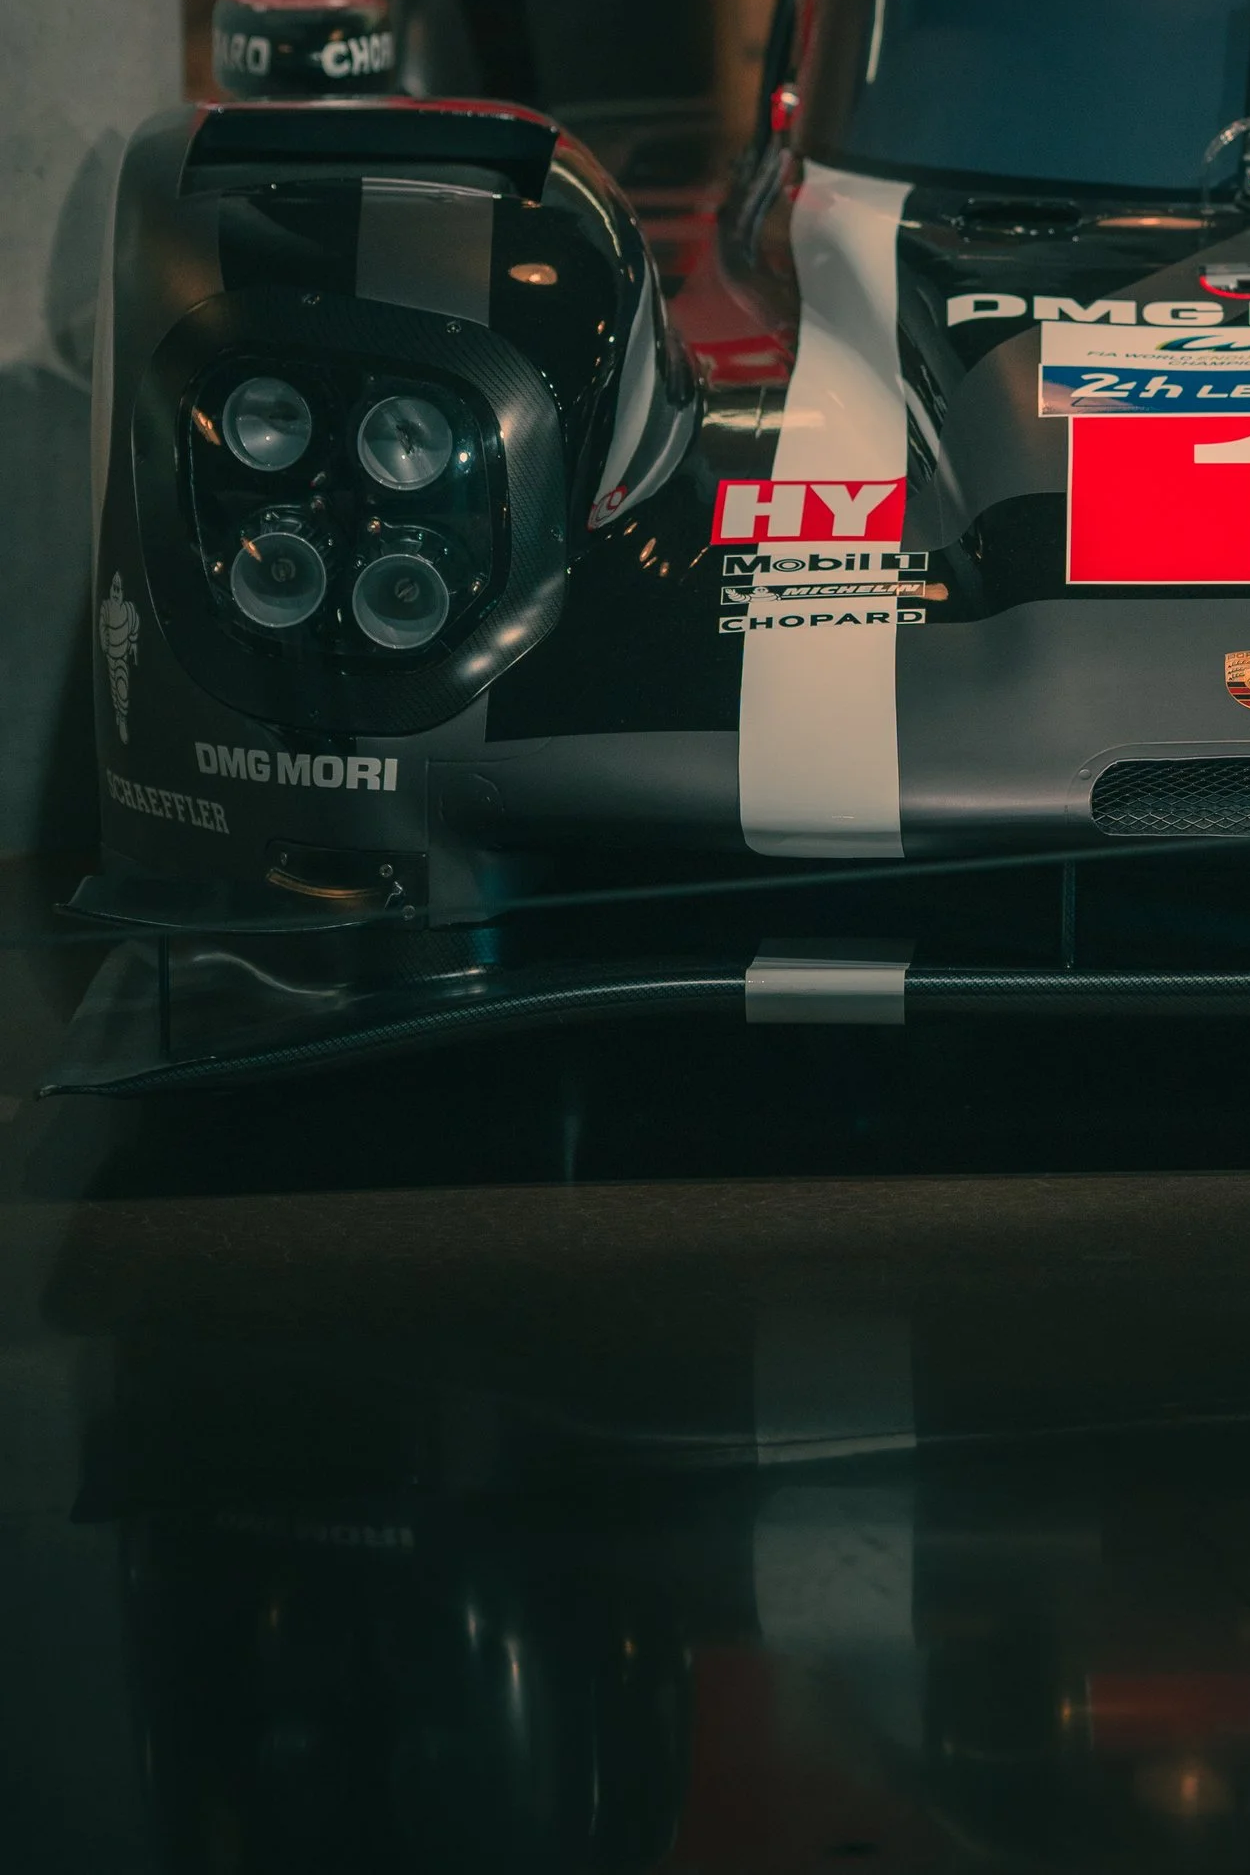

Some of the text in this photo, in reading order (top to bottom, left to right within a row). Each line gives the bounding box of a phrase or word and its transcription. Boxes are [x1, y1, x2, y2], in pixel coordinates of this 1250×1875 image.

[947, 293, 1224, 327] DMG
[1124, 352, 1194, 361] WORLD
[720, 483, 898, 539] HY
[724, 553, 870, 573] Mobil
[783, 583, 921, 596] MICHELIN
[721, 610, 923, 632] CHOPARD
[194, 741, 399, 792] DMG MORI
[106, 766, 231, 835] SCHAEFFLER
